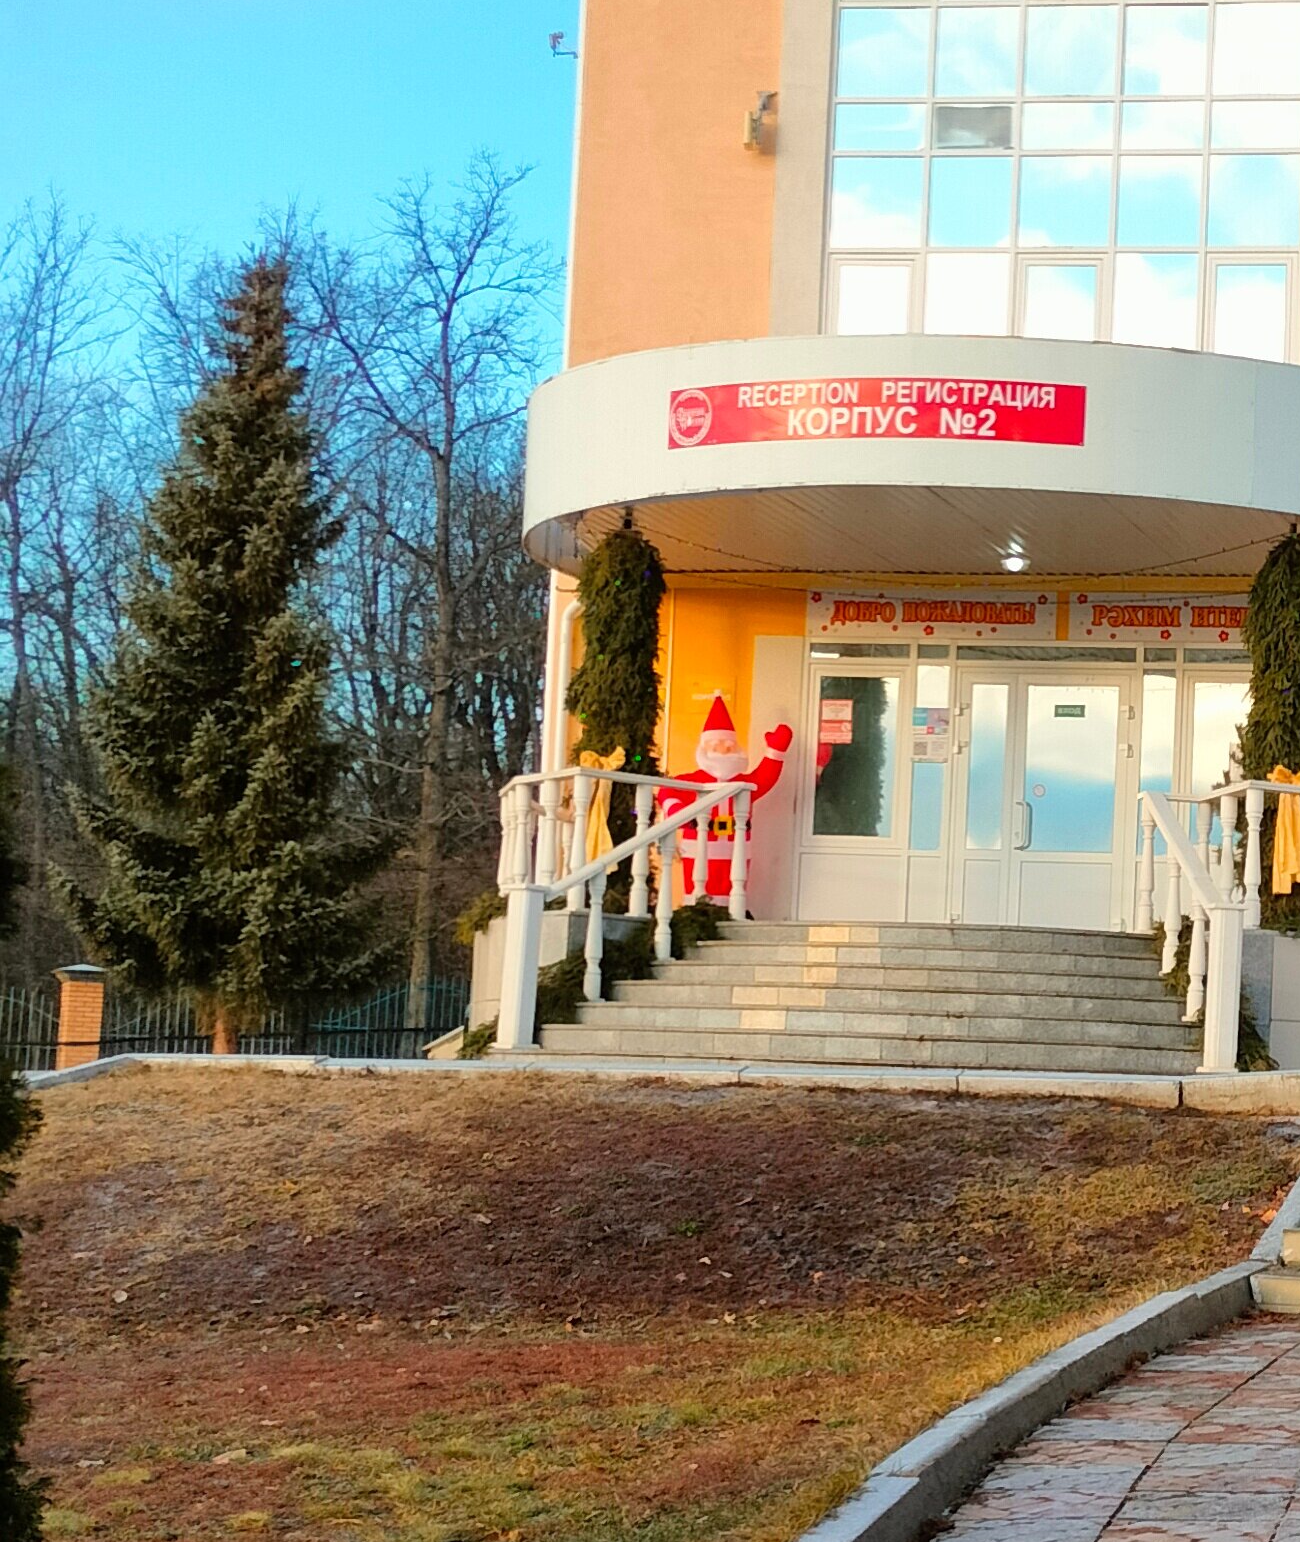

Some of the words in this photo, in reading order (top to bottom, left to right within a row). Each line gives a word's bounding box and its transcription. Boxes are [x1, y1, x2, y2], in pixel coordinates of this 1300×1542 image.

[738, 381, 859, 408] RECEPTION
[881, 380, 1056, 411] РЕГИСТРАЦИЯ
[787, 405, 918, 436] КОРПУС
[939, 407, 997, 437] №2
[830, 600, 897, 626] ДОБРО
[901, 599, 1036, 625] ПОЖАЛОВАТЬ!
[1091, 605, 1182, 628] РӘХИМ
